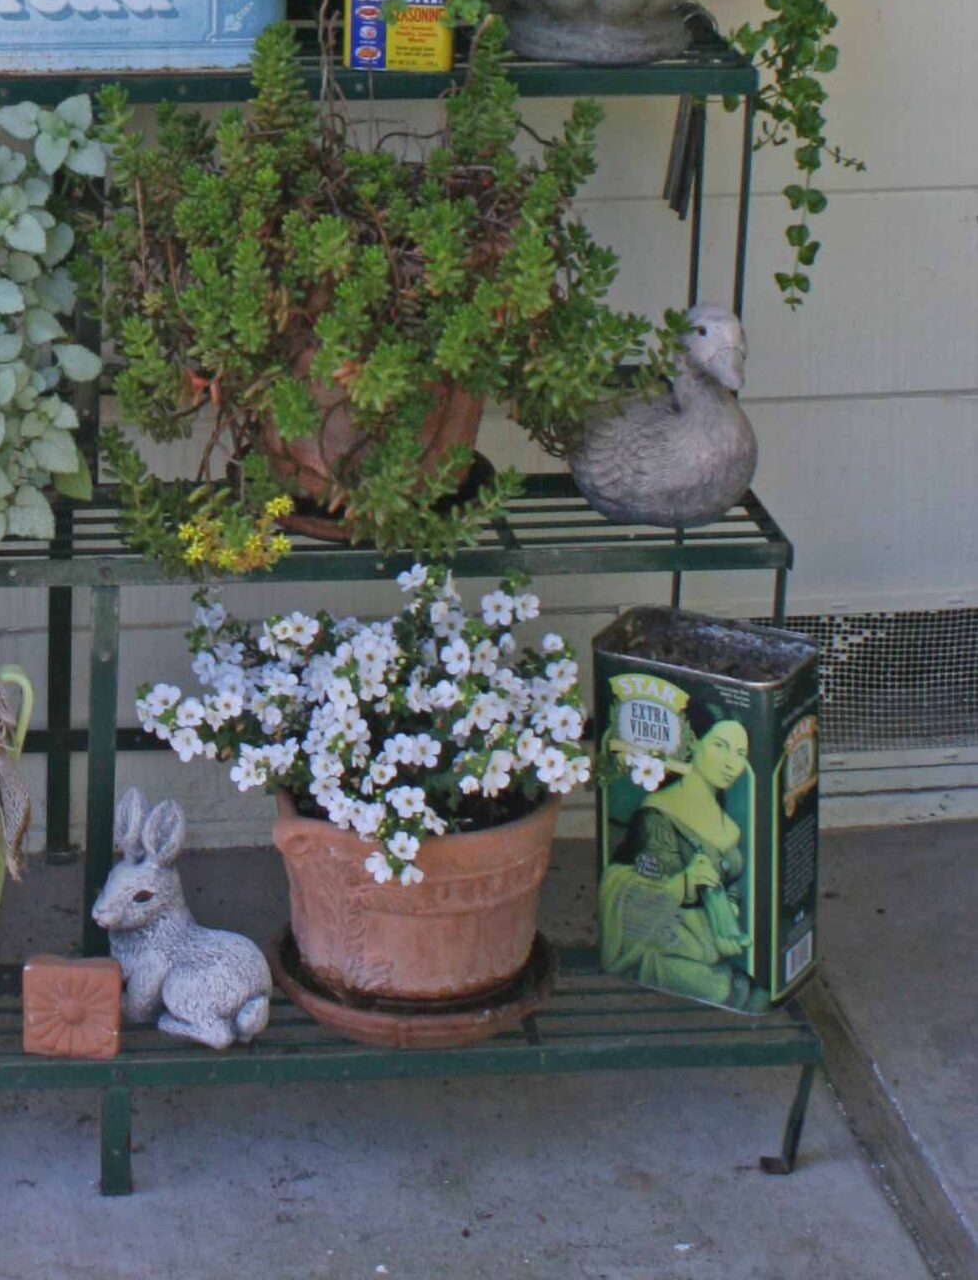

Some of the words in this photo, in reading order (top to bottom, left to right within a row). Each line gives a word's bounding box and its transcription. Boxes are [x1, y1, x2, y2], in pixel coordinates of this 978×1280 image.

[618, 675, 676, 705] STAR
[630, 701, 669, 725] EXTRA
[629, 718, 671, 743] VIRGIN
